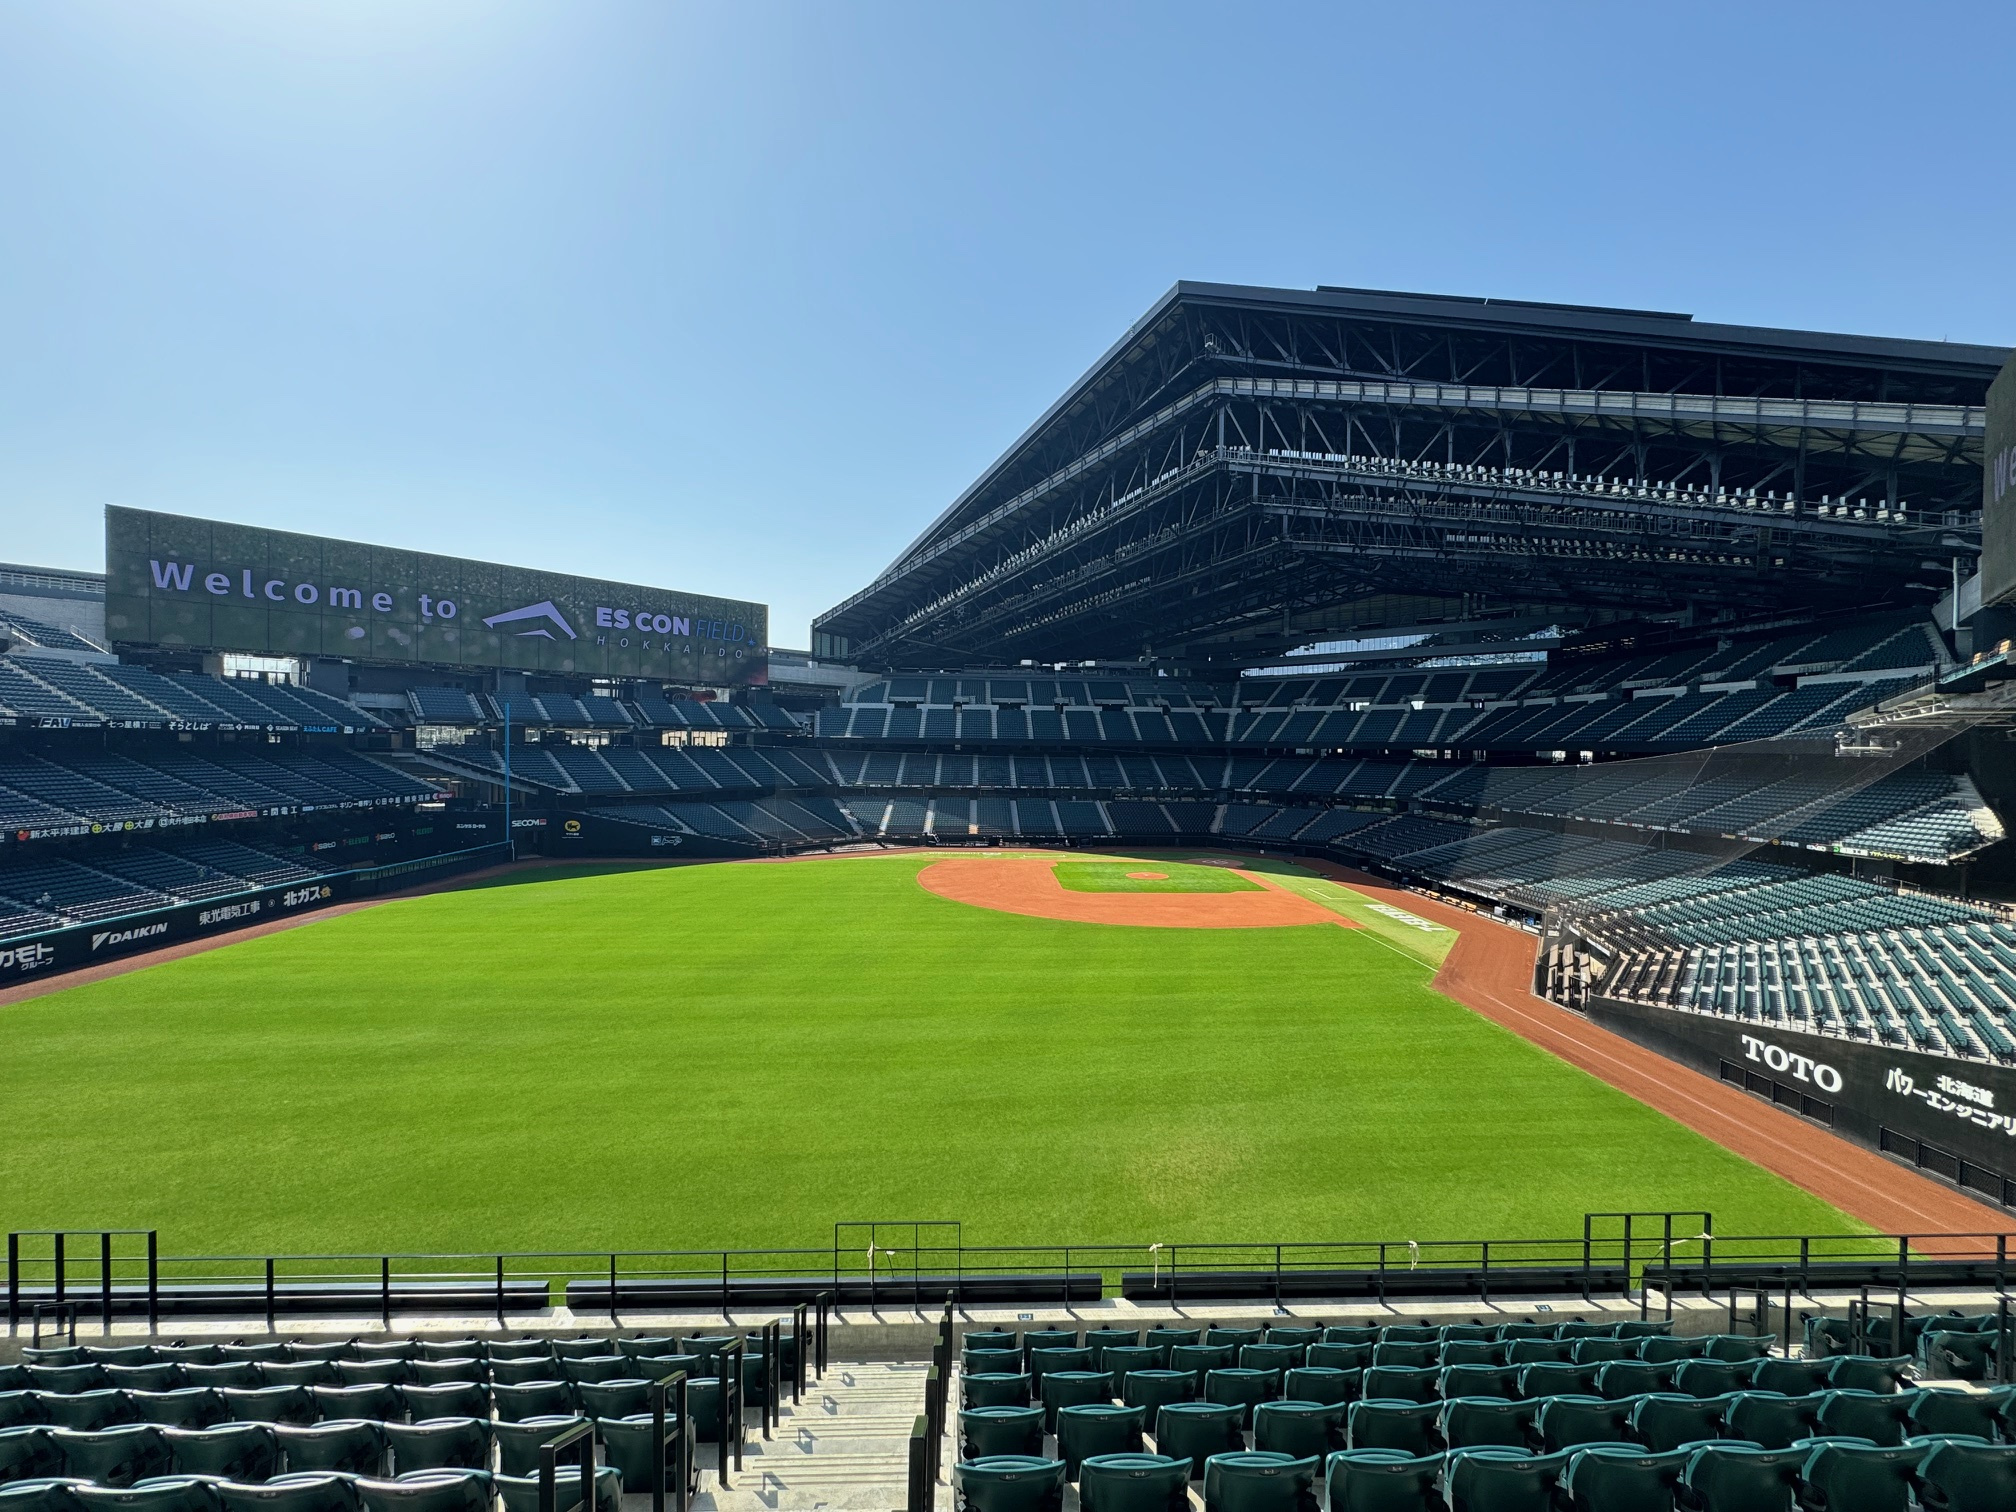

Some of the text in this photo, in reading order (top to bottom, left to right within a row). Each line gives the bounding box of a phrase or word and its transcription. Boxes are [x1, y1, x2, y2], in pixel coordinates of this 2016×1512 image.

[149, 559, 457, 619] Welcome to
[596, 606, 745, 642] ES CON FIELD
[596, 635, 744, 659] HOKKAIDO
[168, 721, 212, 731] そらとしば
[512, 818, 540, 828] SECOM
[283, 886, 321, 907] 北ガス
[199, 900, 260, 926] 東光電気工事
[108, 922, 168, 945] DAIKIN
[1742, 1034, 1843, 1094] TOTO
[1937, 1074, 1995, 1109] 北海道
